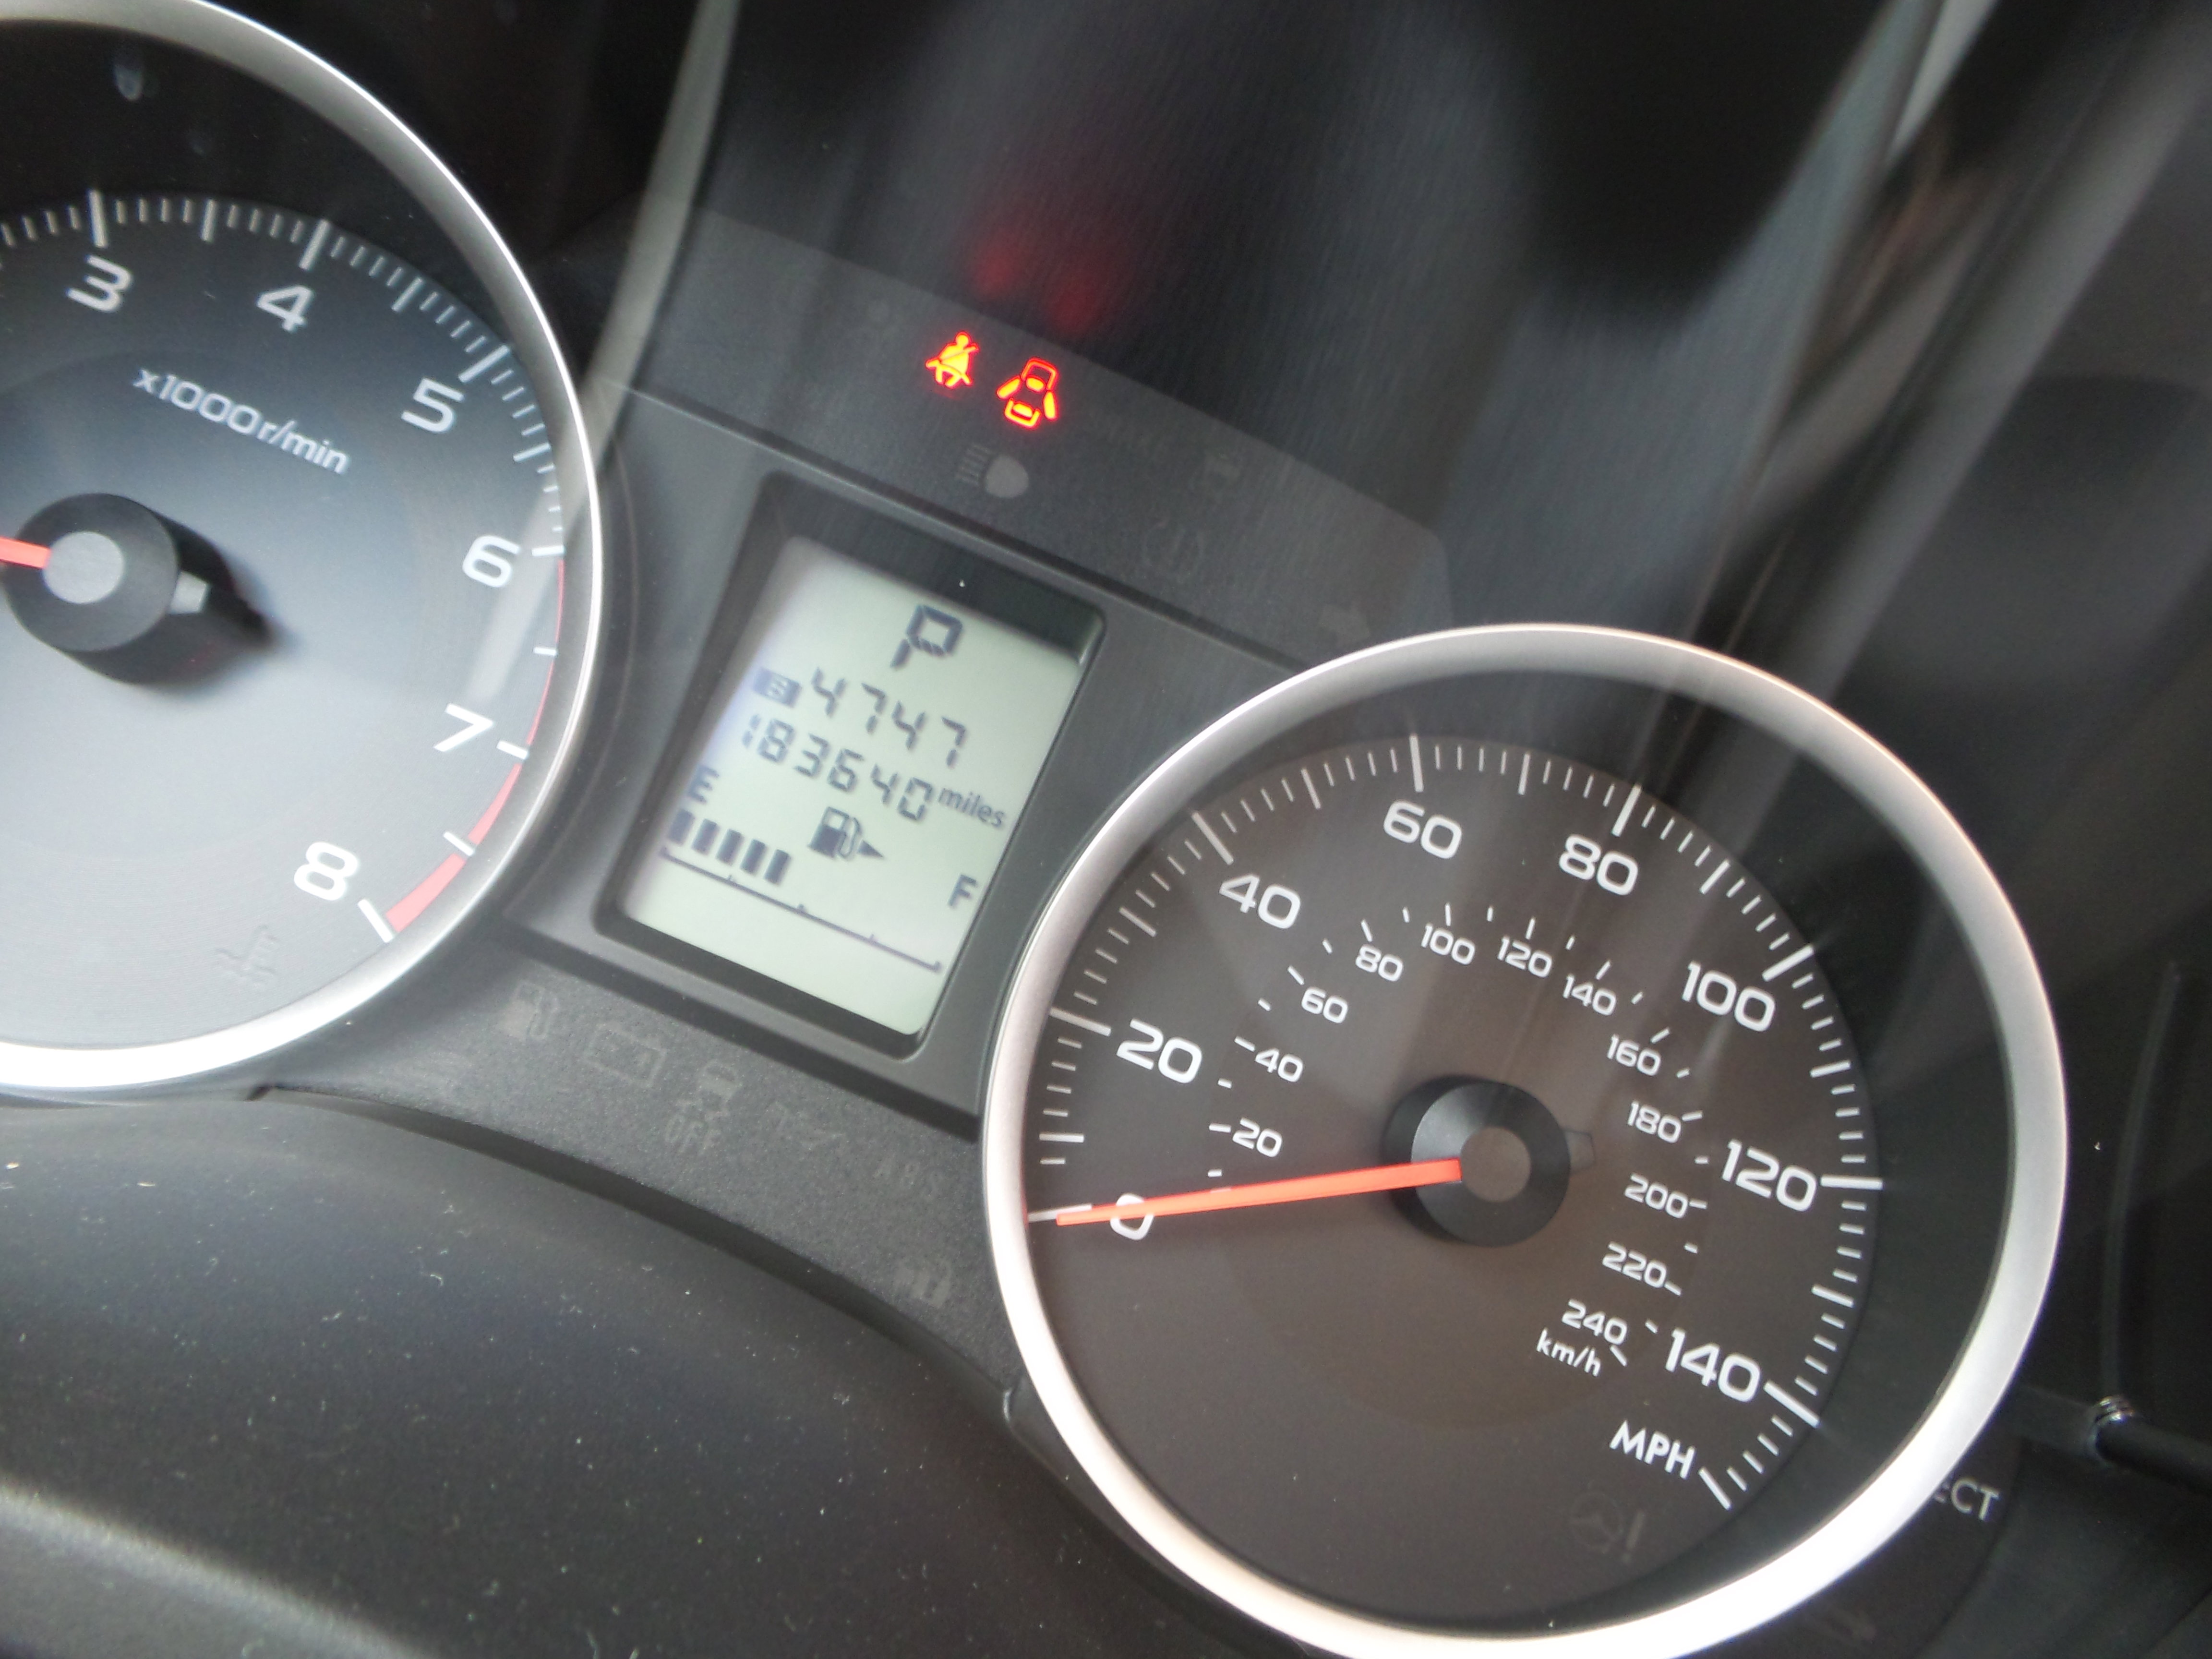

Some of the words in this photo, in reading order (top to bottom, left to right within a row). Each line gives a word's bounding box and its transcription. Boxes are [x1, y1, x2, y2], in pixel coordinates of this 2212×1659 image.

[67, 255, 134, 313] 3
[256, 285, 314, 332] 4
[400, 378, 464, 433] 5
[462, 535, 521, 588] 6
[890, 603, 963, 670] P
[433, 703, 493, 752] 7
[811, 667, 967, 768] 4747
[686, 765, 720, 803] E
[742, 714, 934, 822] 183640
[939, 787, 1006, 829] miles
[1383, 800, 1462, 859] 60
[293, 842, 360, 901] 8
[1559, 834, 1638, 895] 80
[948, 874, 977, 909] F
[1219, 874, 1300, 929] 40
[1355, 944, 1404, 982] 80
[1421, 923, 1476, 965] 100
[1497, 936, 1553, 977] 120
[1301, 986, 1348, 1023] 60
[1563, 974, 1617, 1016] 140
[1682, 962, 1775, 1032] 100
[1116, 1018, 1202, 1083] 20
[1255, 1047, 1303, 1082] 40
[1607, 1034, 1661, 1076] 160
[1232, 1118, 1282, 1157] 20
[1626, 1100, 1681, 1143] 180
[1624, 1173, 1688, 1219] 200
[1722, 1139, 1817, 1212] 120
[1109, 1193, 1154, 1240] 0
[1602, 1241, 1668, 1288] 220
[1561, 1298, 1628, 1345] 240
[1536, 1327, 1601, 1377] km/h
[1665, 1327, 1761, 1402] 140
[1610, 1419, 1696, 1479] MPH
